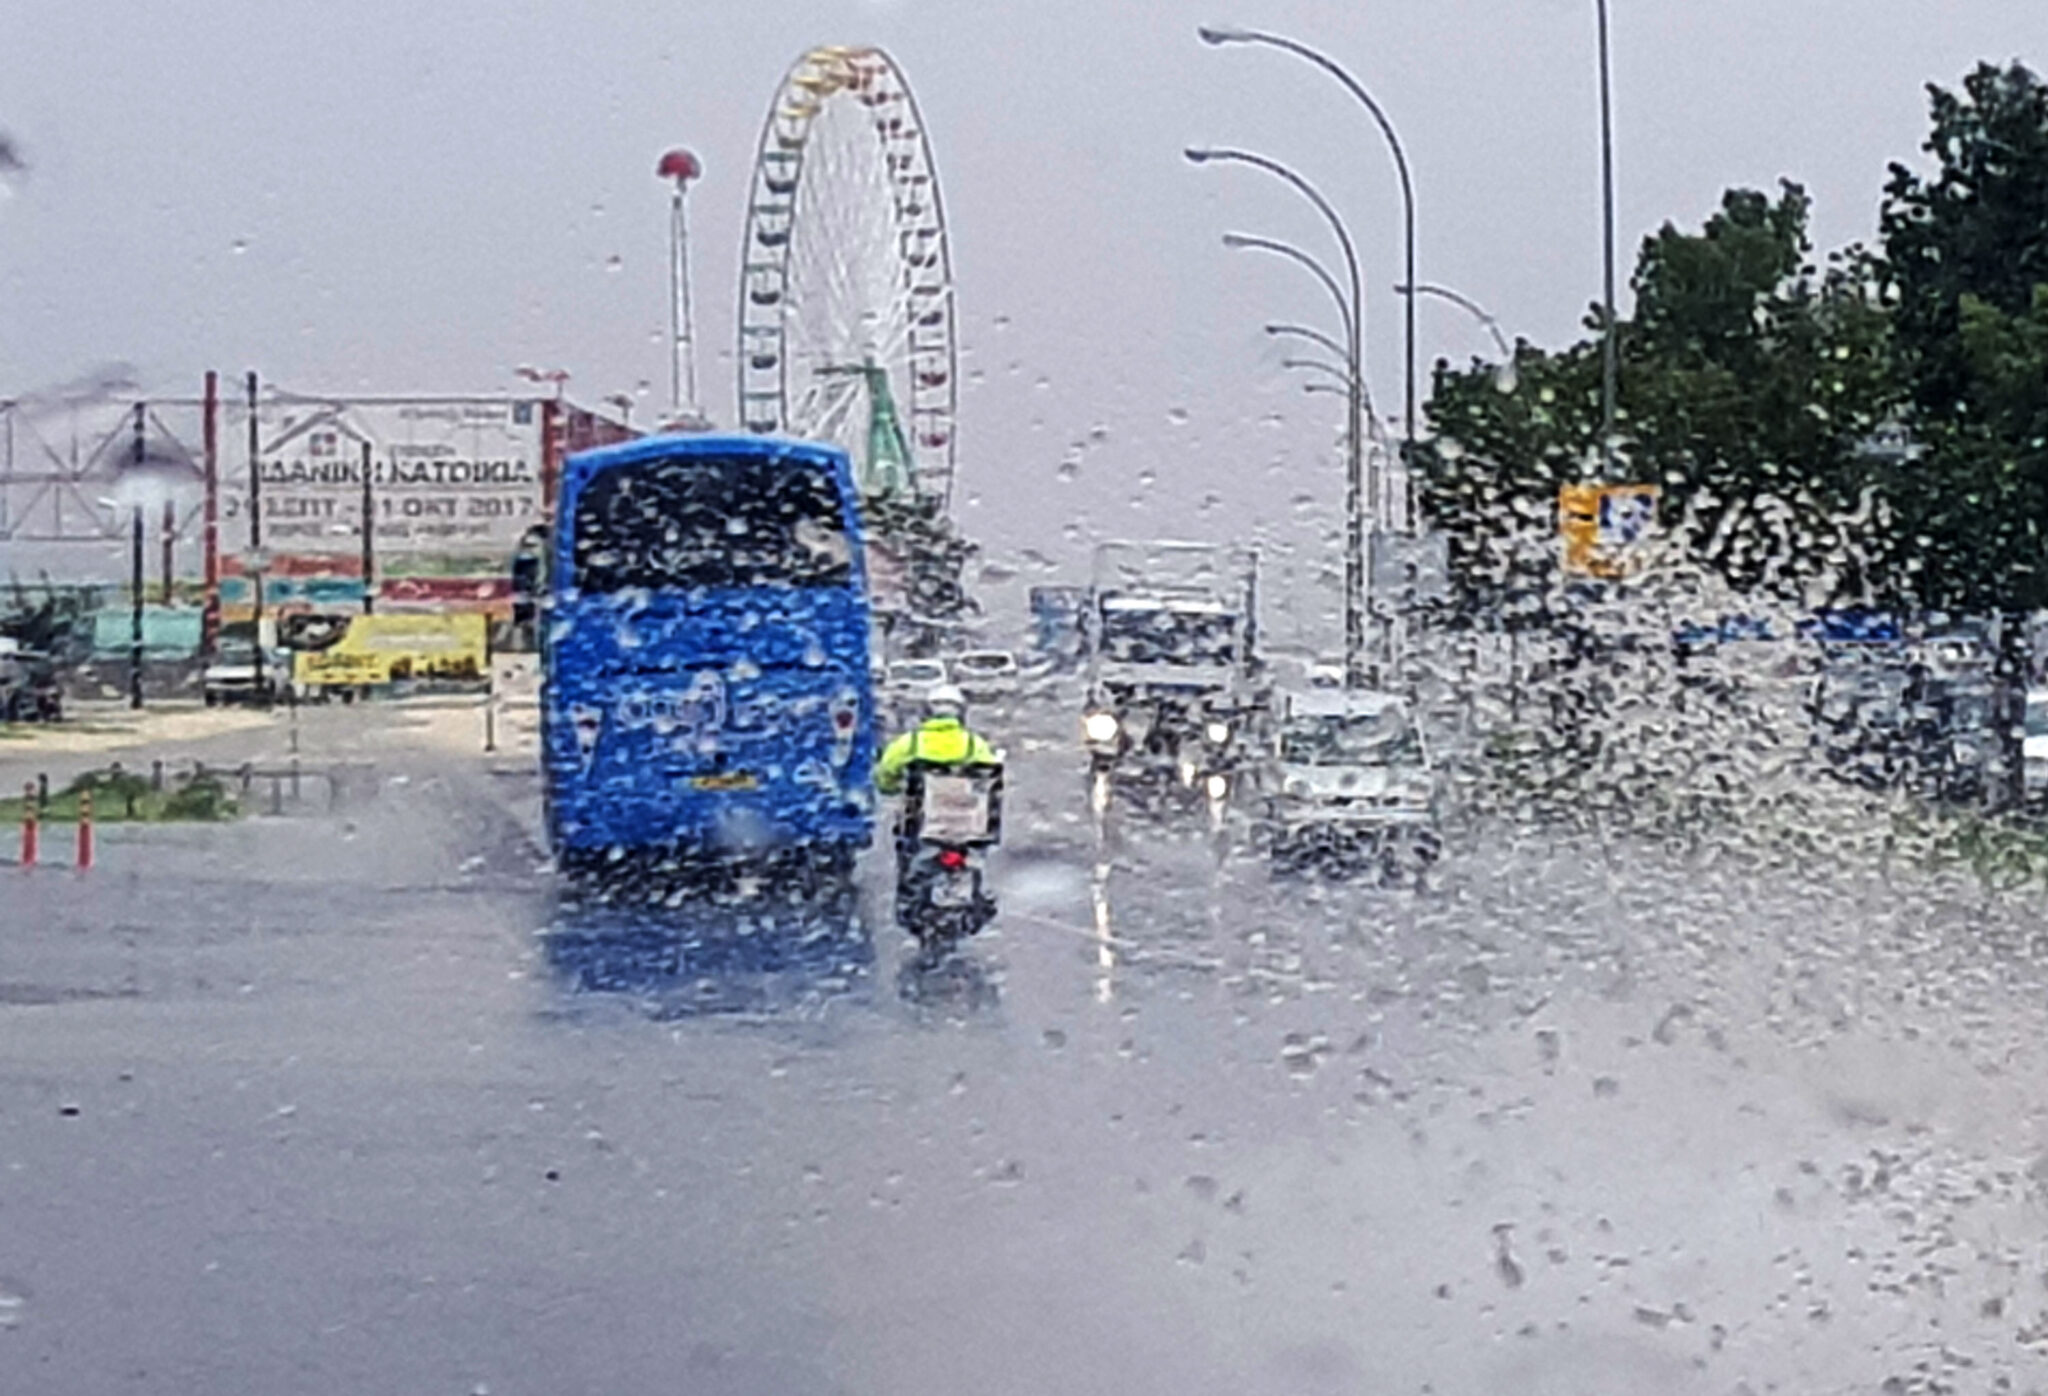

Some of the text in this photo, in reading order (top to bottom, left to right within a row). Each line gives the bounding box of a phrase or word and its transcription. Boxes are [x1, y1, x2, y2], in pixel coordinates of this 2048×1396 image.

[390, 460, 533, 483] ΚΑΤΟΙΚΙΑ
[403, 497, 456, 517] ΟΚΤ
[468, 497, 533, 516] 2017
